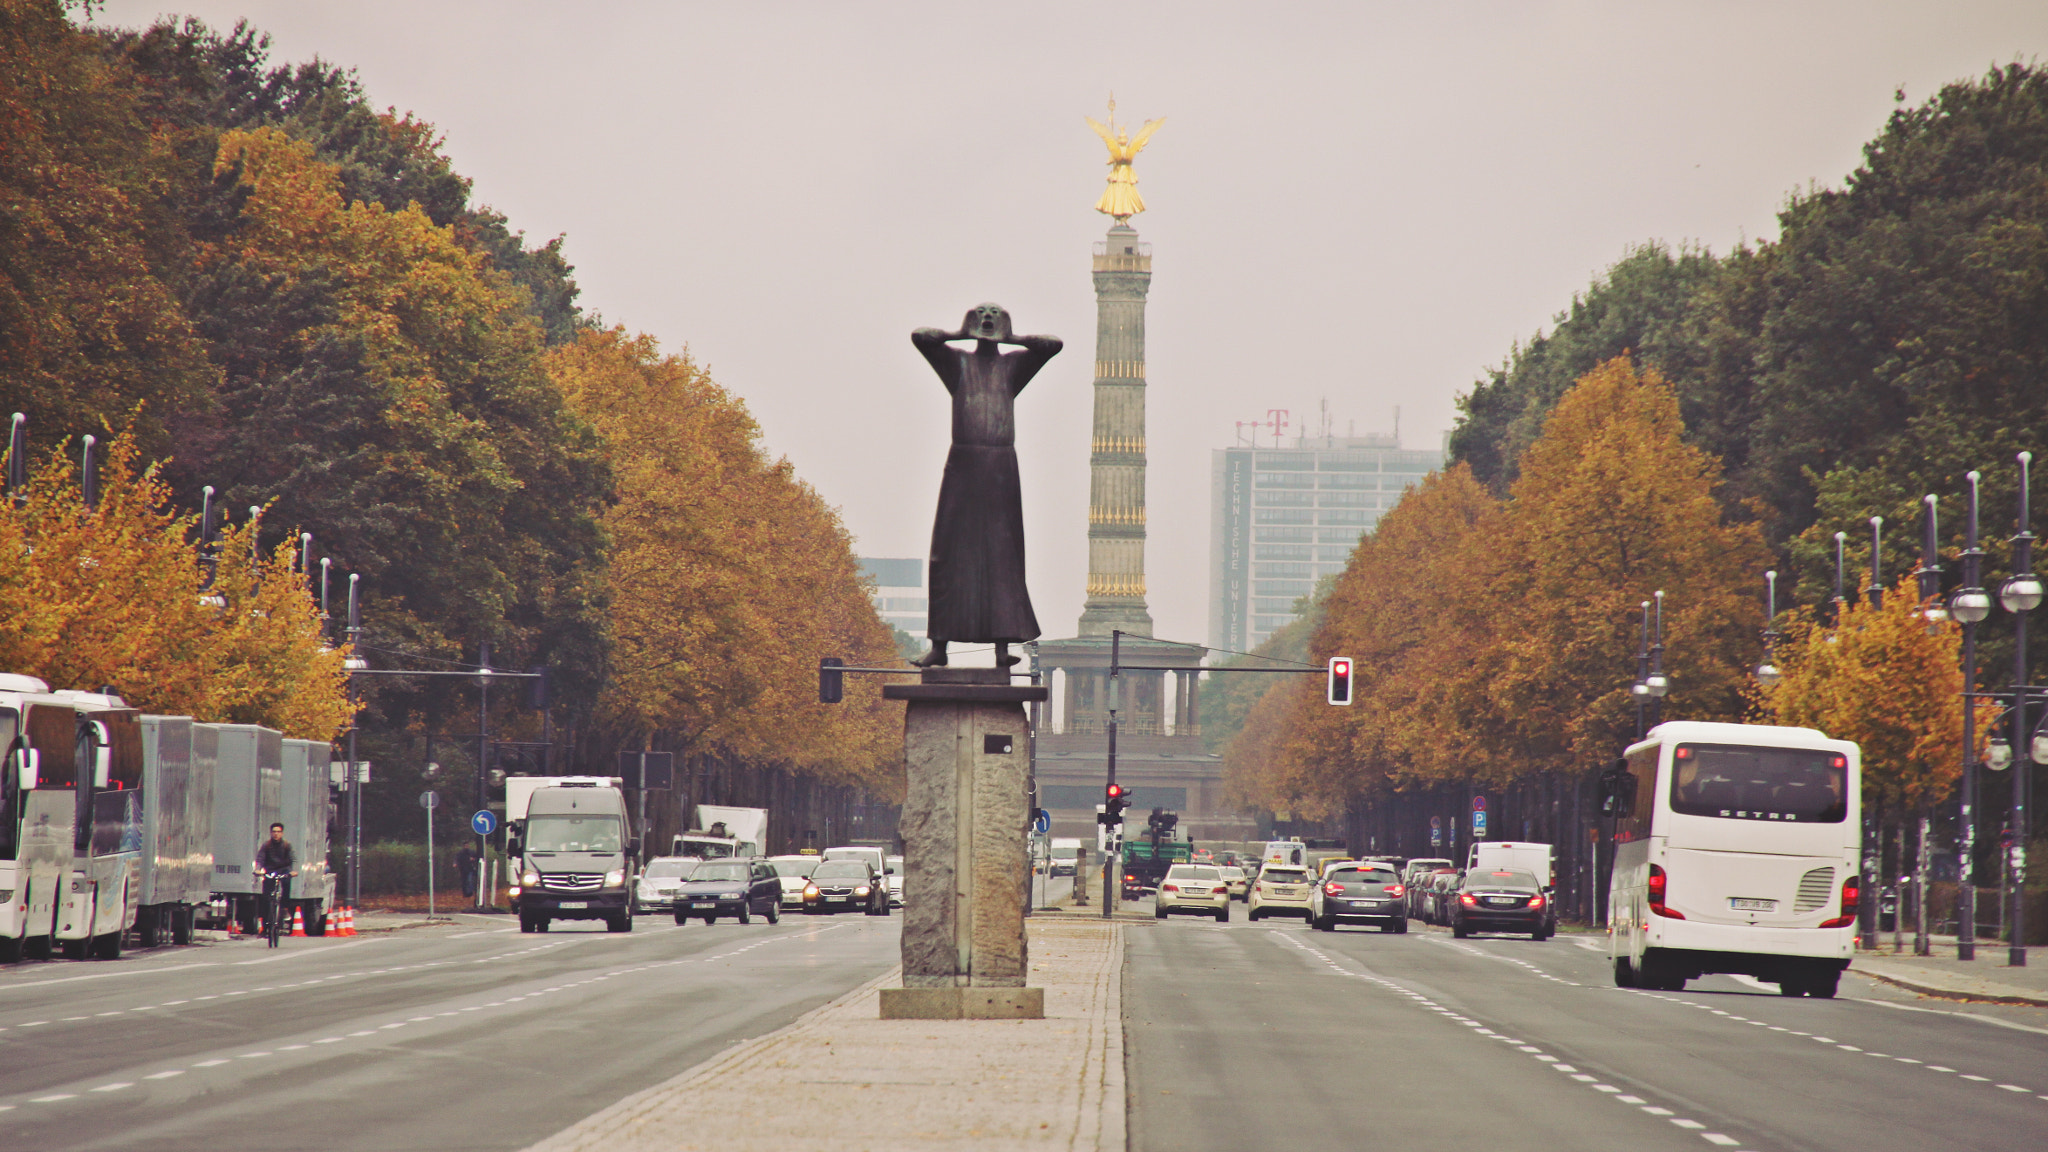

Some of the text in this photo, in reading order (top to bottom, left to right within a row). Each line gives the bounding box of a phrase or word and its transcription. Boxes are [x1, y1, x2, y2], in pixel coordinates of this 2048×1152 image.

[1267, 409, 1289, 436] T
[1232, 461, 1240, 570] TECHNISCHE
[1719, 809, 1796, 820] SETRA
